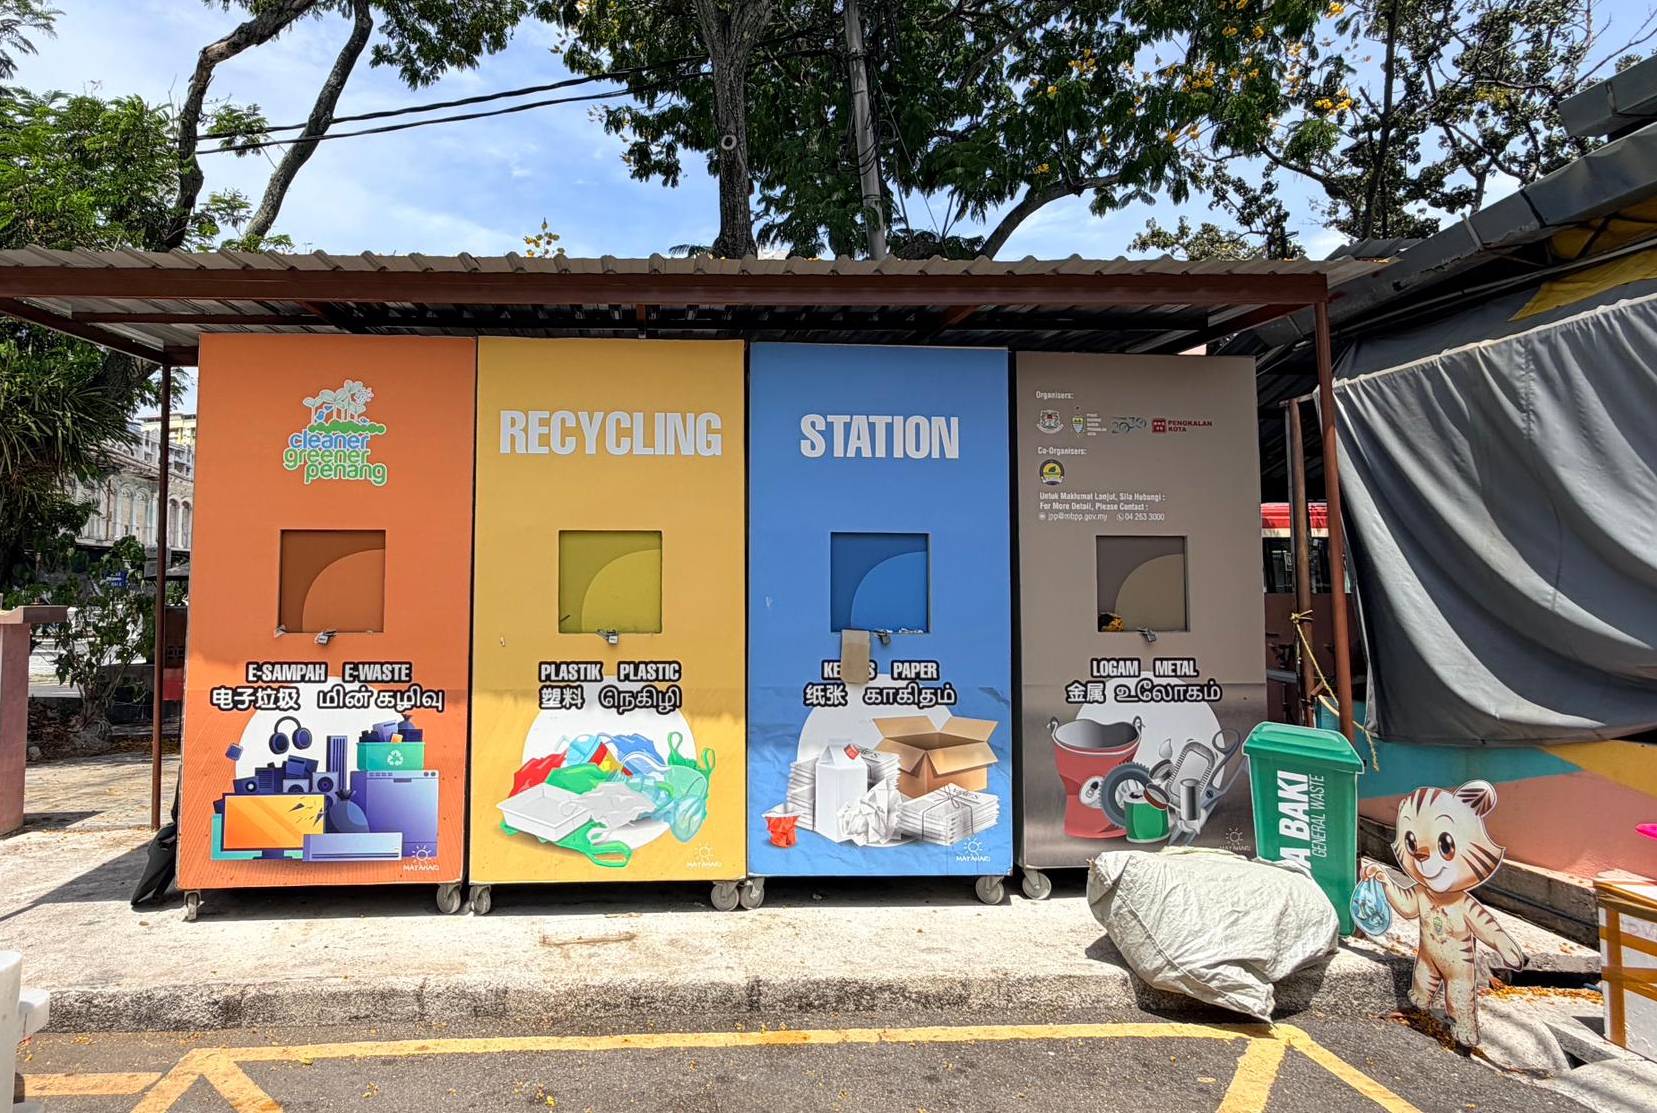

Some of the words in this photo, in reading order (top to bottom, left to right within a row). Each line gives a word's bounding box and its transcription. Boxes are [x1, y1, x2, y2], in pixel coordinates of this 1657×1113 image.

[1035, 390, 1074, 400] Organisers:
[1167, 419, 1213, 427] PENGKALAN
[289, 429, 370, 449] cleaner
[499, 410, 722, 456] RECYCLING
[800, 414, 959, 459] STATION
[283, 449, 370, 470] greener
[1037, 446, 1088, 456] Co-Organisers:
[305, 464, 387, 485] penang
[1039, 492, 1059, 500] Untuk
[1060, 492, 1093, 500] Maklumat
[1119, 492, 1133, 500] Sila
[1039, 502, 1051, 510] For
[1052, 502, 1070, 510] More
[1095, 502, 1118, 510] Please
[1119, 502, 1145, 510] Contact
[247, 663, 326, 682] E-SAMPAH
[344, 663, 411, 682] E-WASTE
[540, 663, 602, 681] PLASTIK
[619, 663, 680, 681] PLASTIC
[823, 662, 877, 679] KES
[892, 661, 939, 679] PAPER
[1092, 660, 1140, 677] LOGAM
[1154, 660, 1198, 677] METAL
[212, 687, 299, 709] 电子垃圾
[318, 685, 372, 708] மின்
[376, 685, 443, 711] கழிவு
[540, 686, 583, 708] 塑料
[600, 686, 681, 713] நெகிழி
[805, 684, 847, 706] 纸张
[863, 683, 956, 708] காகிதம்
[1067, 682, 1105, 702] 金属
[1115, 680, 1222, 702] உலோகம்
[1308, 773, 1326, 811] WASTE
[1277, 769, 1311, 841] BAKI
[1310, 813, 1328, 858] GENERAL
